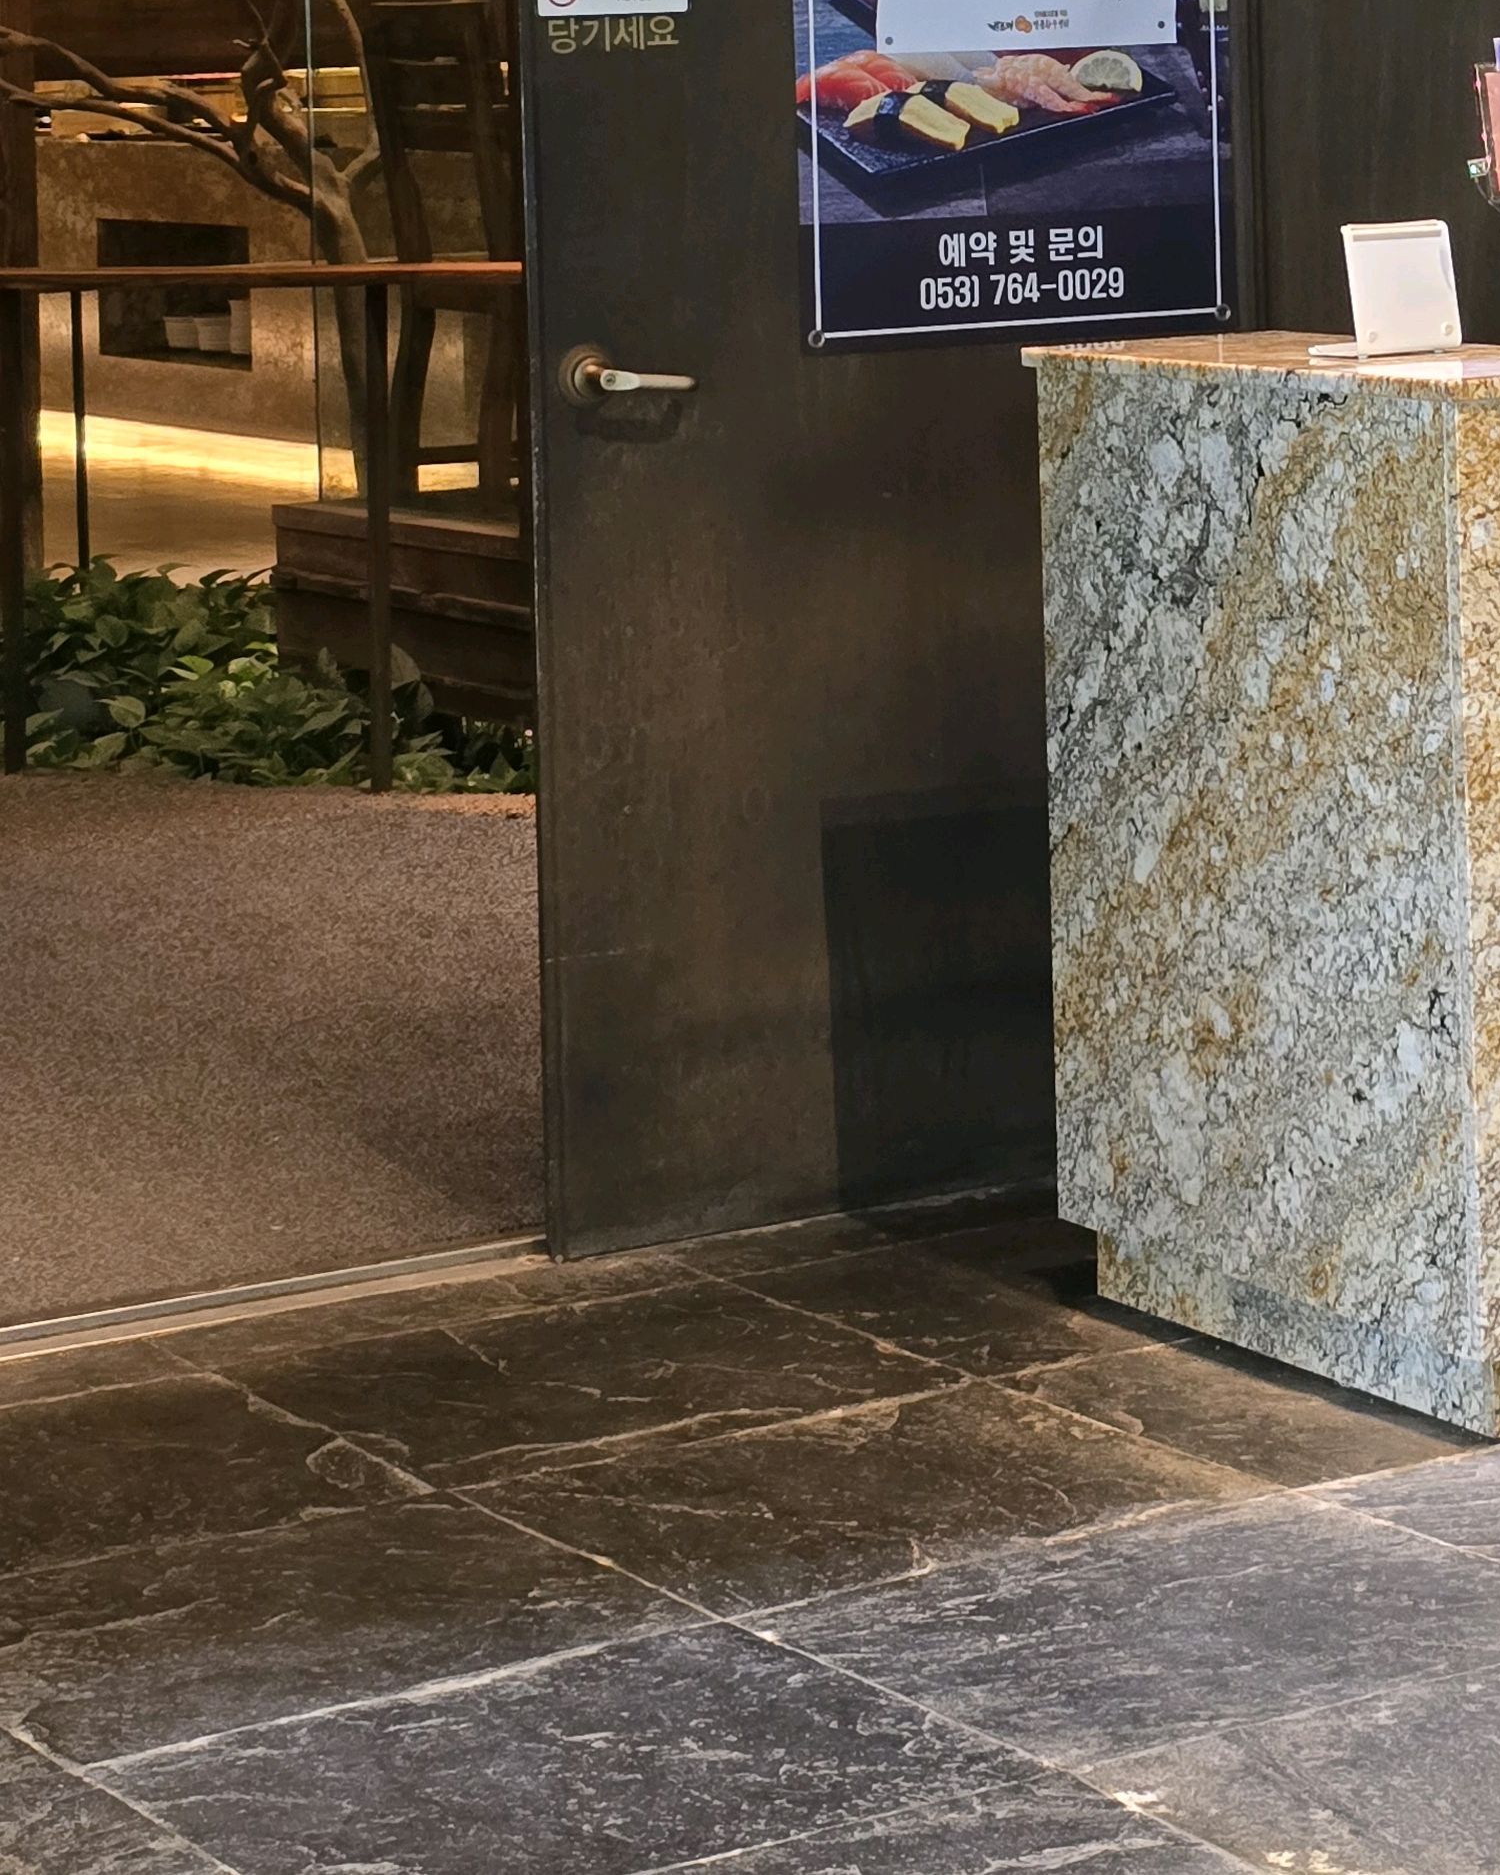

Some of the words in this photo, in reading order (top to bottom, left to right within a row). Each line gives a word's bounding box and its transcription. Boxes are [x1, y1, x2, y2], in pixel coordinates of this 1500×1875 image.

[548, 15, 679, 54] 당기세요
[939, 231, 996, 267] 예약
[1009, 228, 1035, 264] 및
[1048, 225, 1103, 262] 문의
[919, 275, 979, 310] 053)
[989, 267, 1124, 305] 764-0029
